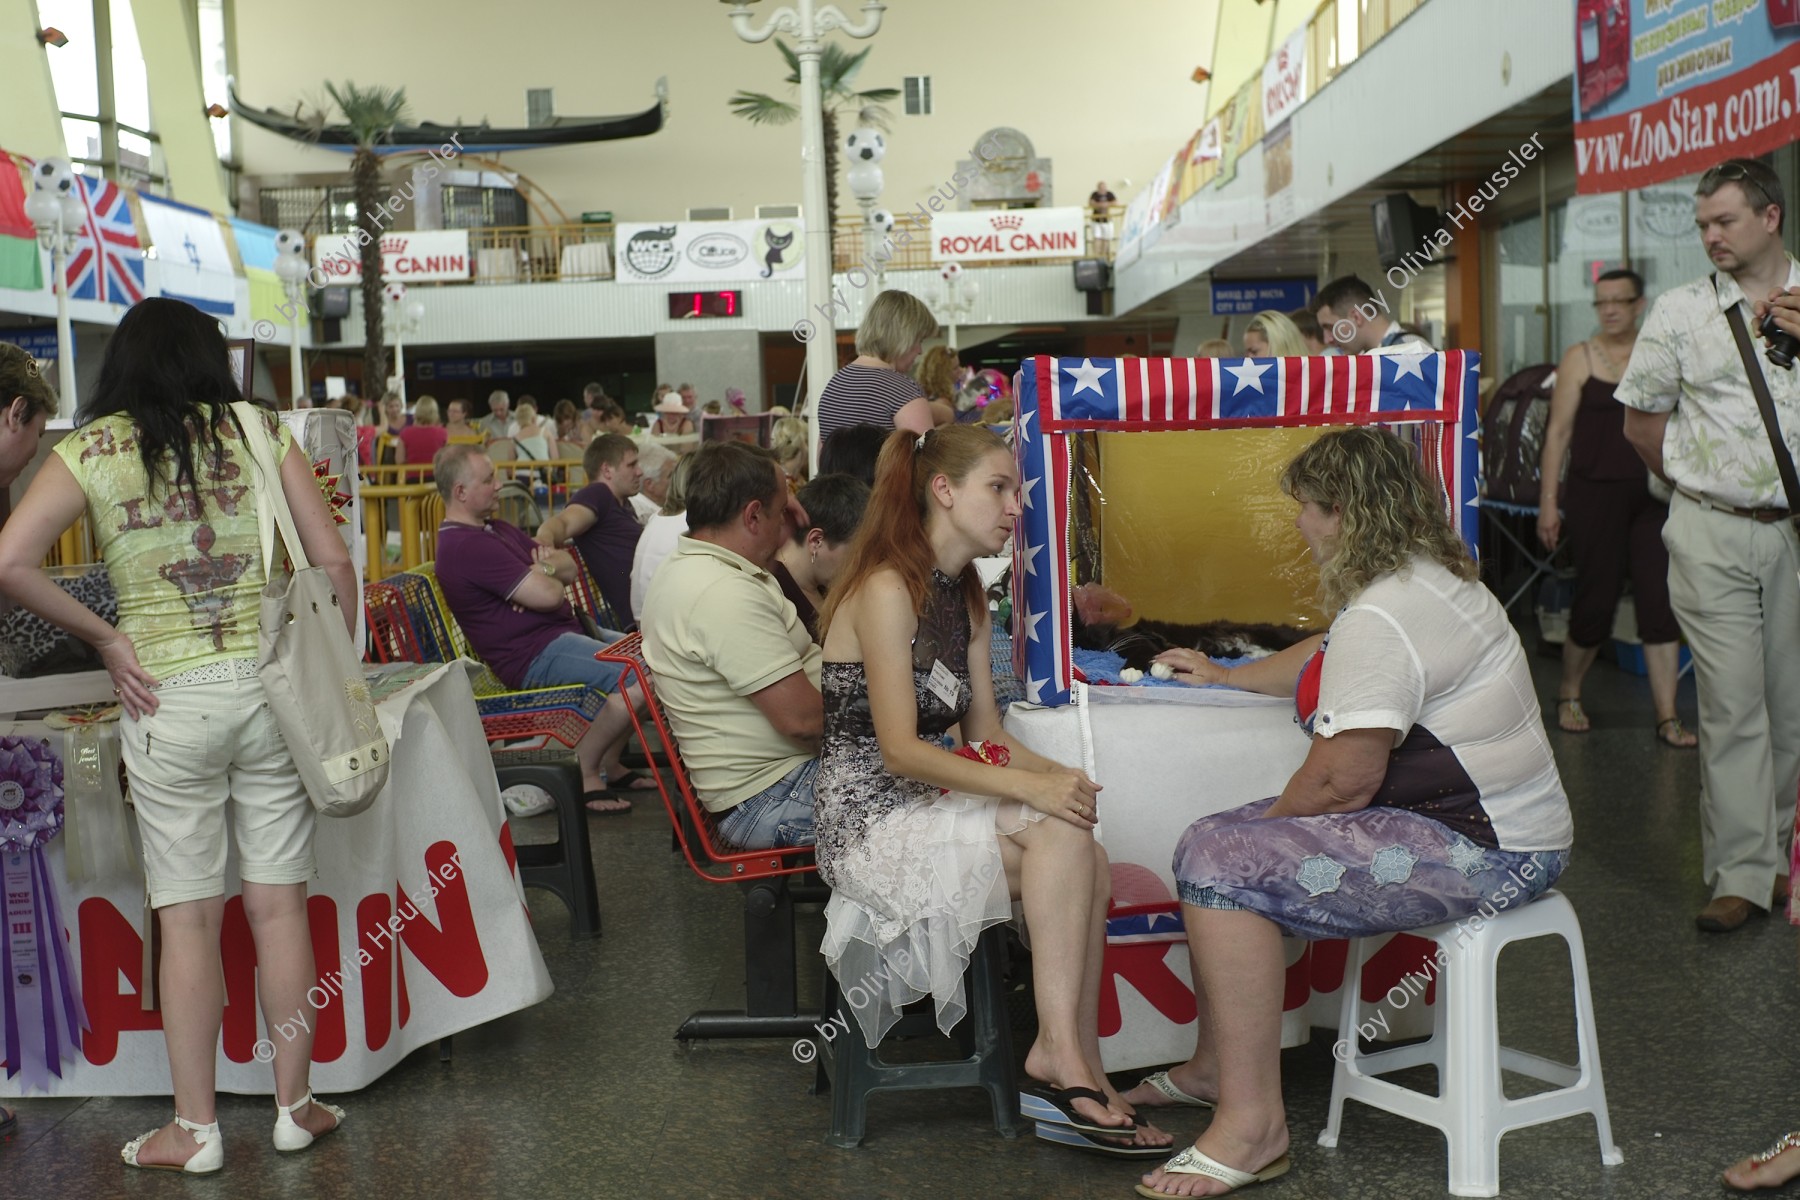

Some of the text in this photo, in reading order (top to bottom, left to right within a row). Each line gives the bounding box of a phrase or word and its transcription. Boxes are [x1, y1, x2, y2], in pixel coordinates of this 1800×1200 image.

[630, 240, 673, 253] WCF
[940, 231, 1077, 254] ROYAL CANIN
[322, 254, 464, 276] ROYL CANIN
